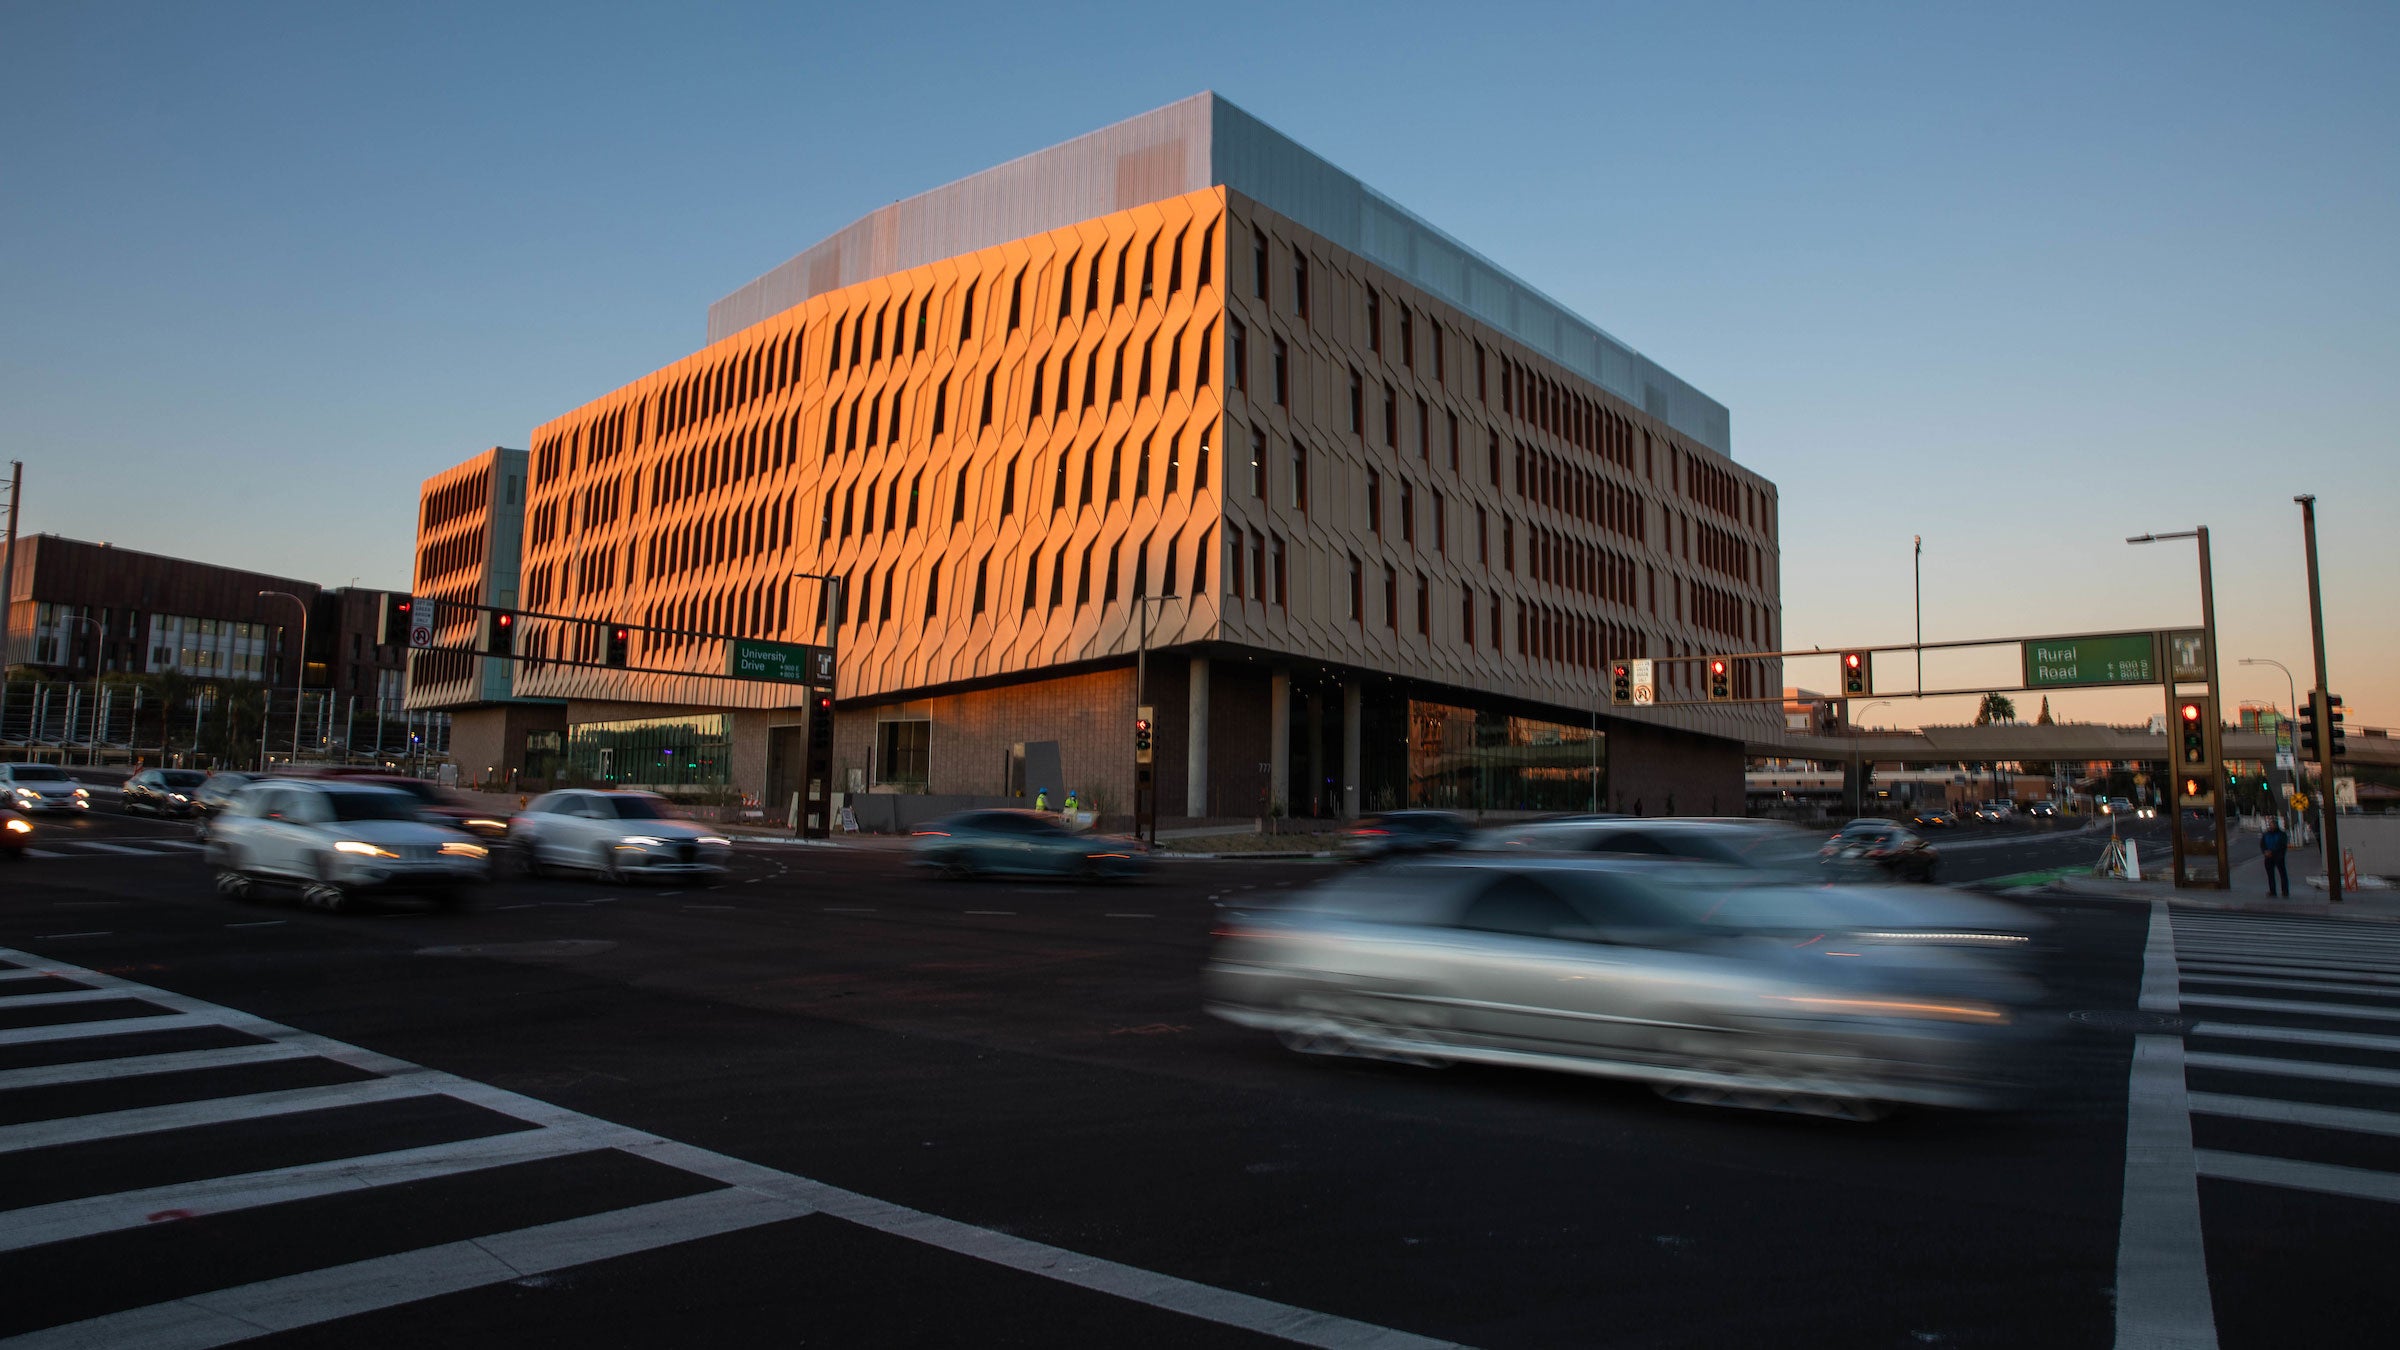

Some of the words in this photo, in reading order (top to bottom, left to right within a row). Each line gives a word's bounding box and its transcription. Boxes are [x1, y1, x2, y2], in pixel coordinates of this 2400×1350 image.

[742, 648, 786, 664] University
[2038, 647, 2076, 662] Rural
[741, 660, 765, 672] Drive
[2119, 660, 2138, 670] 800
[2039, 664, 2077, 680] Road
[2120, 670, 2139, 680] 800
